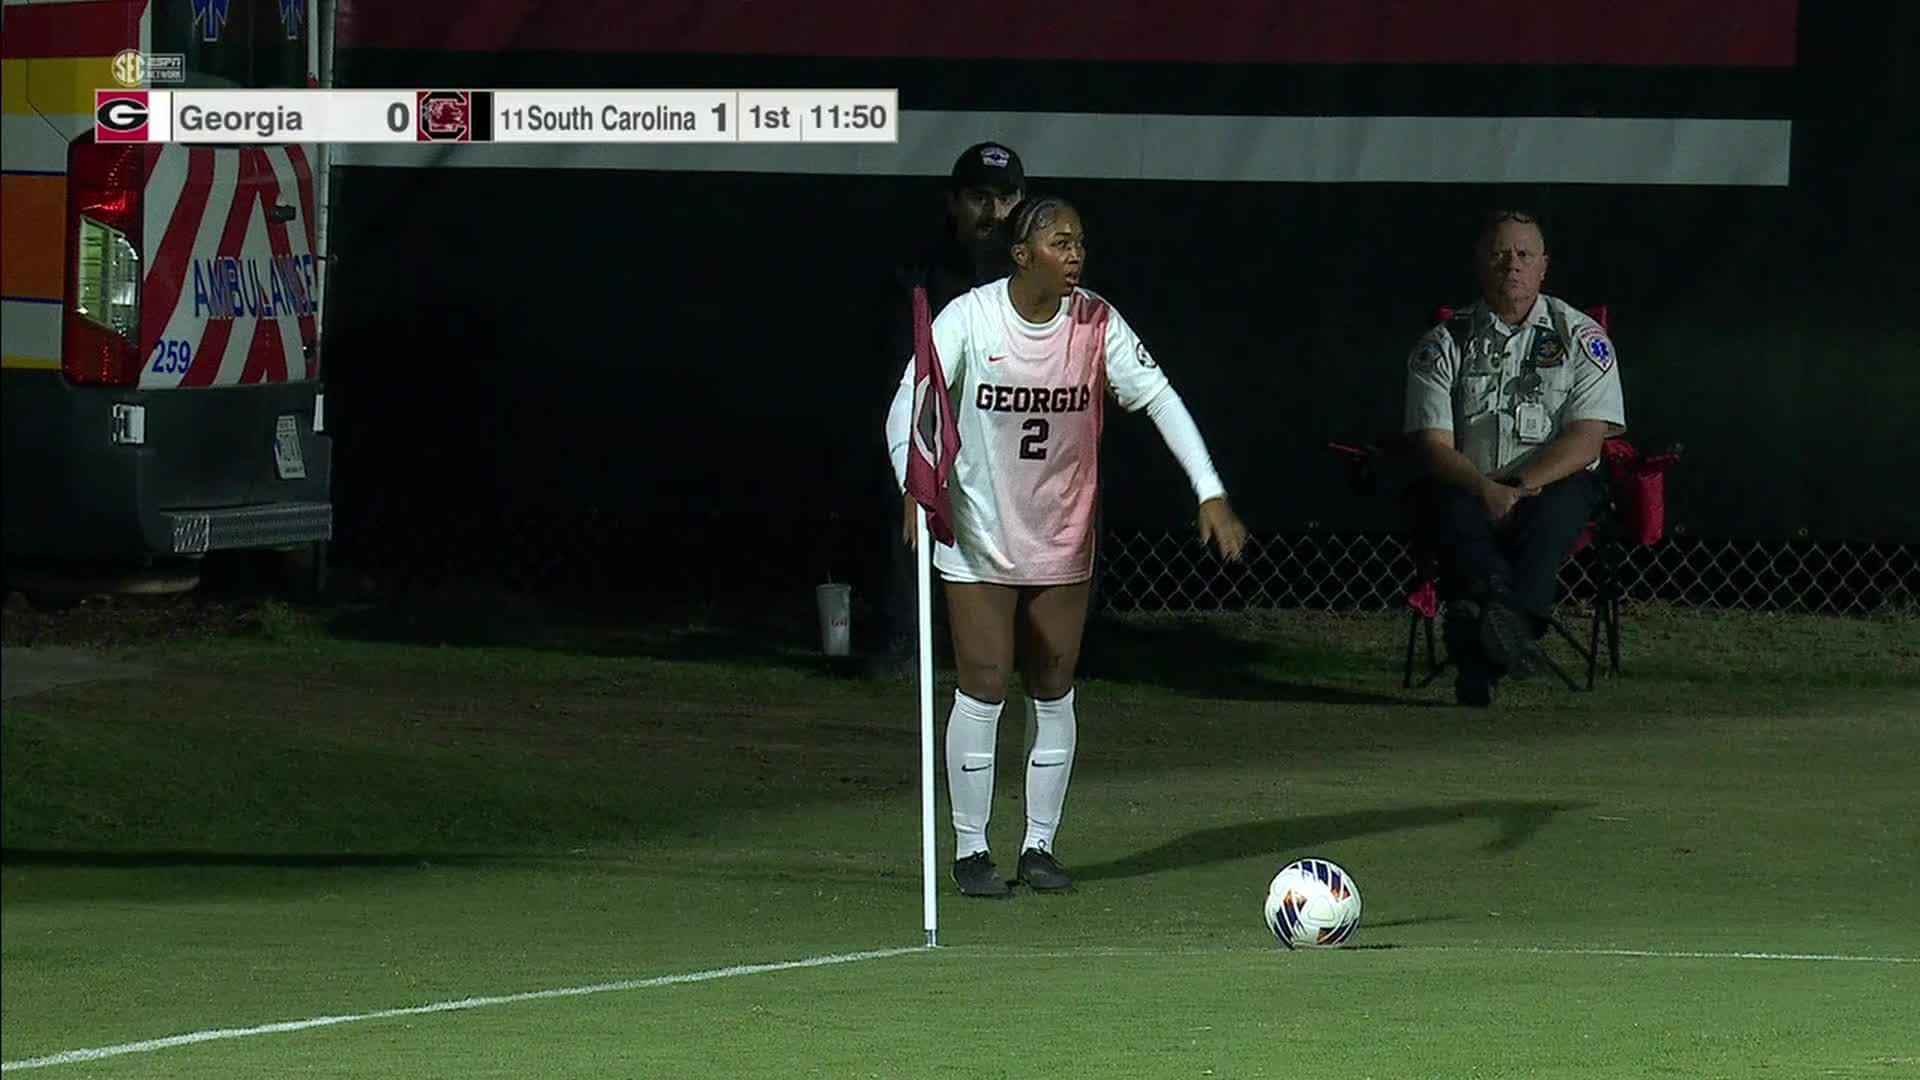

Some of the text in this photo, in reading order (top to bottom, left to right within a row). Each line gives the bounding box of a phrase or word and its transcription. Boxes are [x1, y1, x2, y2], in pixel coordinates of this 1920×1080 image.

[194, 256, 317, 319] AMBULANCE
[152, 340, 191, 373] 259
[976, 383, 1090, 413] GEORGIA
[1019, 418, 1050, 460] 2
